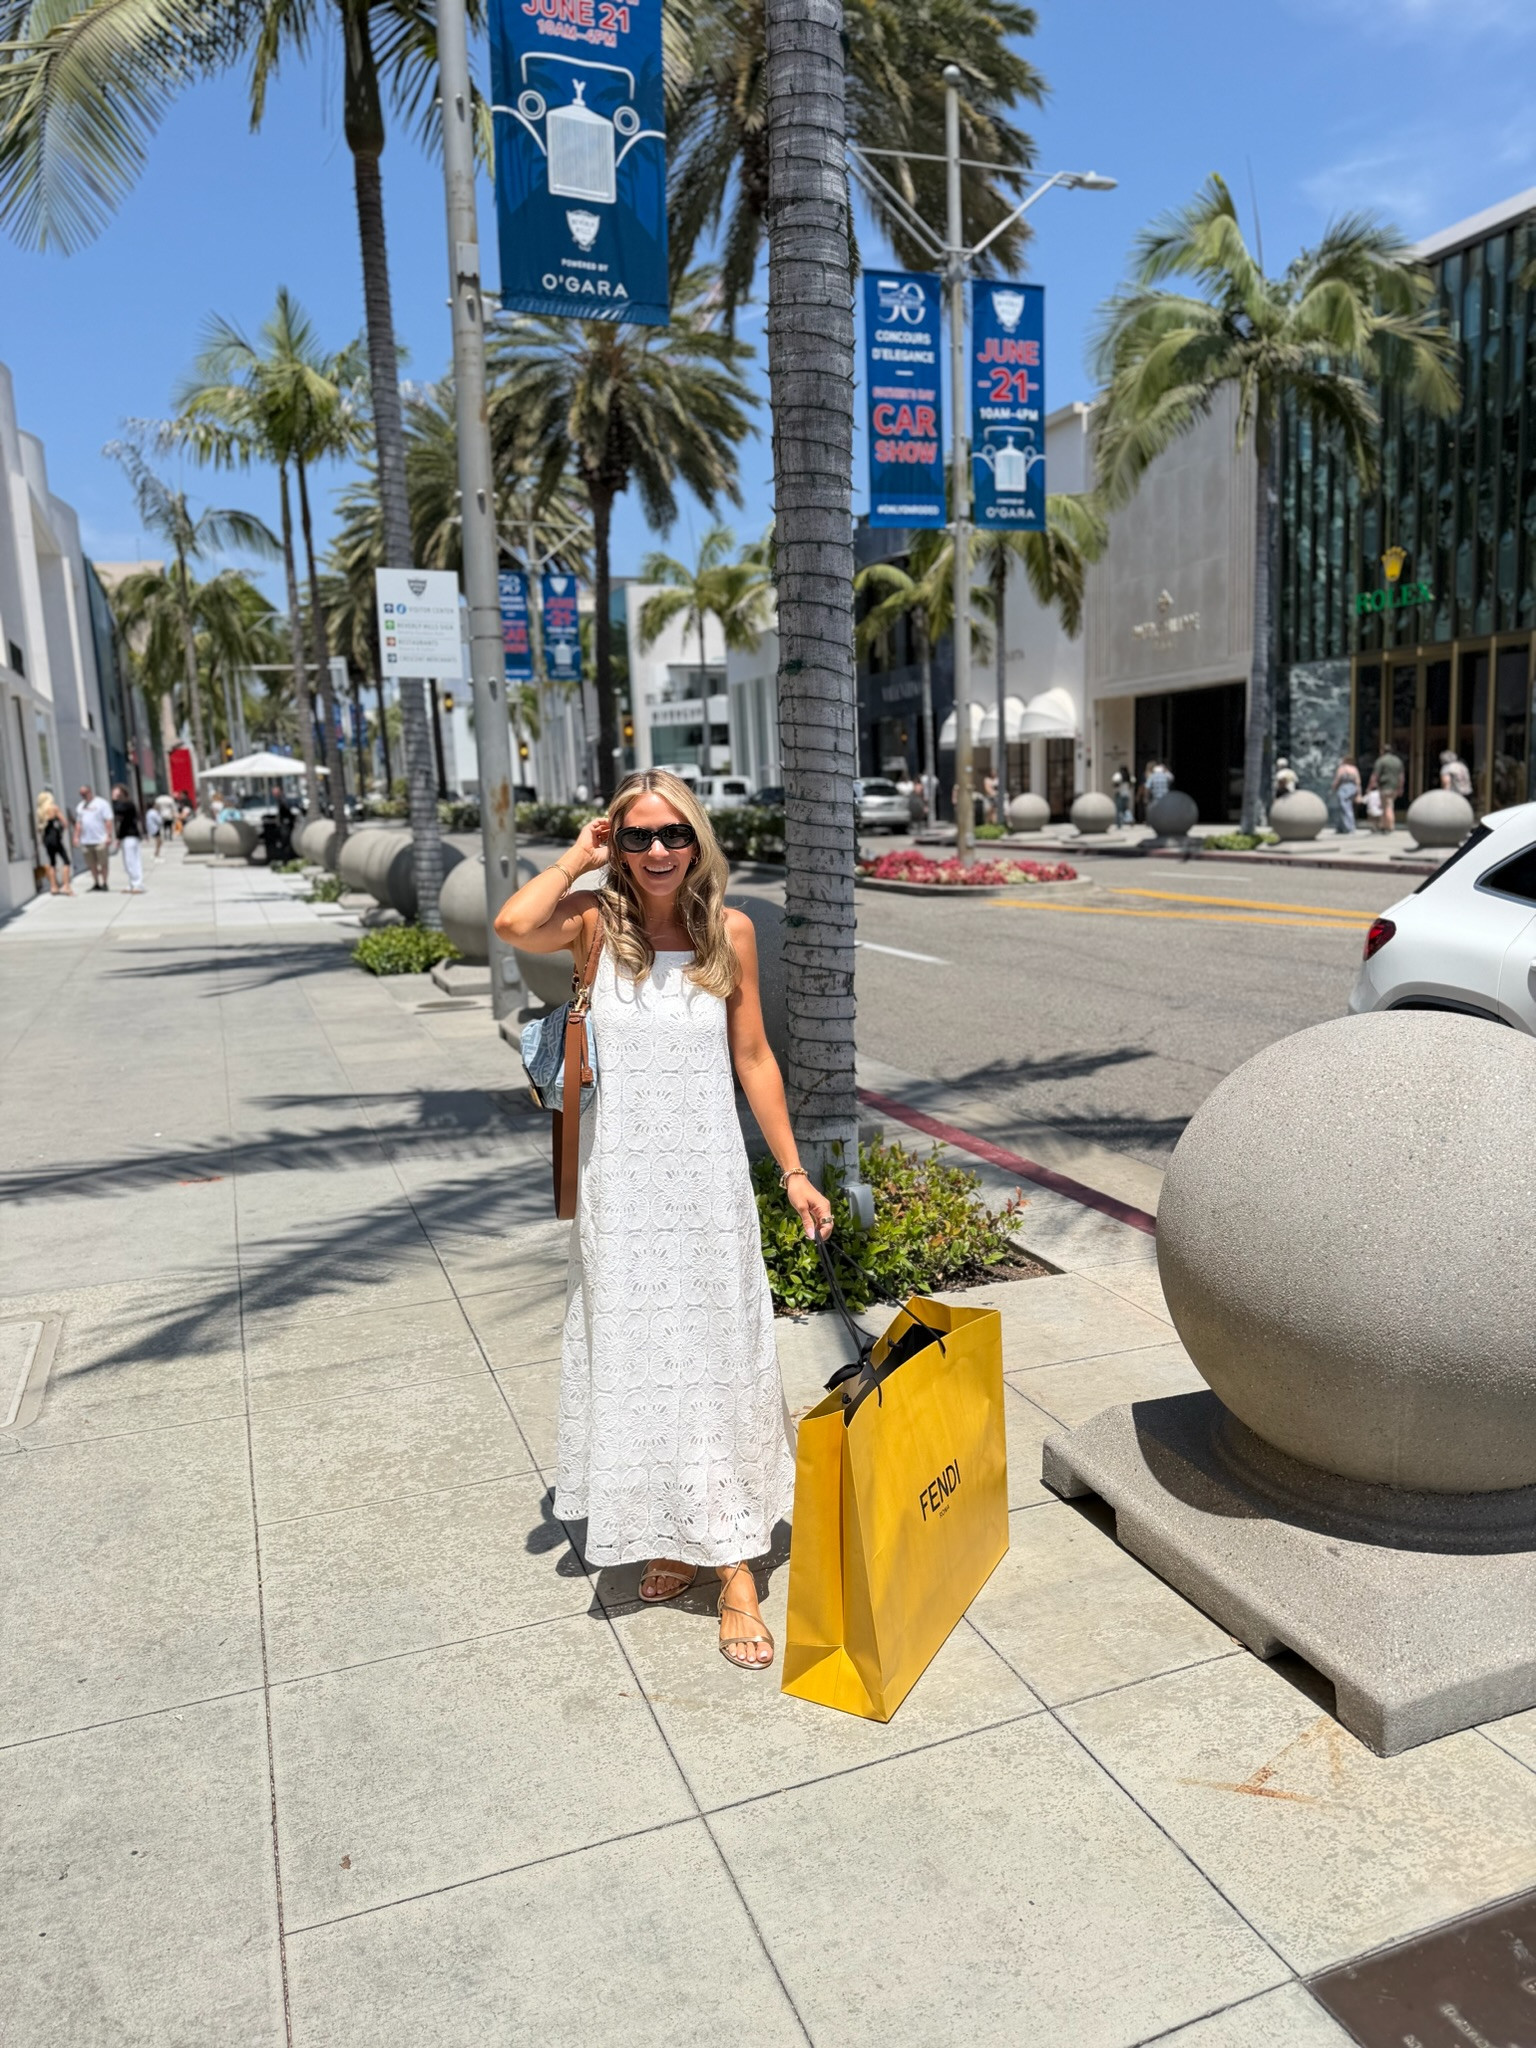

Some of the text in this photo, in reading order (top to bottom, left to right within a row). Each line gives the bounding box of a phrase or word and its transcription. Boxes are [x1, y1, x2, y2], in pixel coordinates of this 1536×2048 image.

[521, 0, 630, 33] JUNE 21
[542, 273, 629, 299] O'GARA
[874, 329, 932, 346] CONCOURS
[871, 347, 935, 365] D'ELEGANCE
[977, 337, 1040, 366] JUNE
[873, 402, 938, 438] CAR
[874, 439, 938, 464] SHOW
[985, 506, 1036, 519] O'GARA
[1355, 582, 1435, 616] ROLEX
[919, 1458, 961, 1521] FENDI
